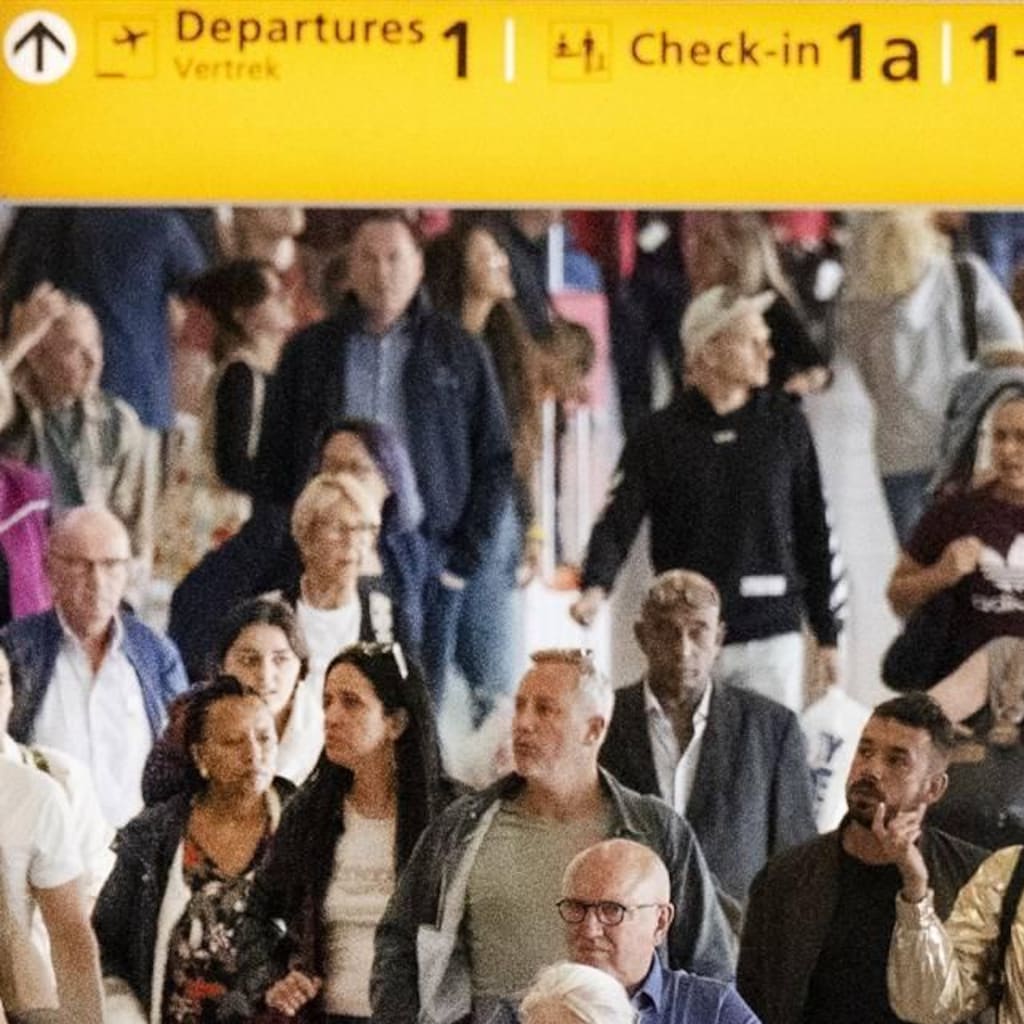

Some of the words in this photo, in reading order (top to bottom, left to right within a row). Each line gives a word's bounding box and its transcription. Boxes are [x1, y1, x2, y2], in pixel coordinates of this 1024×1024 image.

[173, 56, 280, 81] Vertrek
[176, 9, 425, 50] Departures
[441, 20, 470, 79] 1
[630, 30, 820, 67] Check-in
[836, 22, 919, 82] 1a
